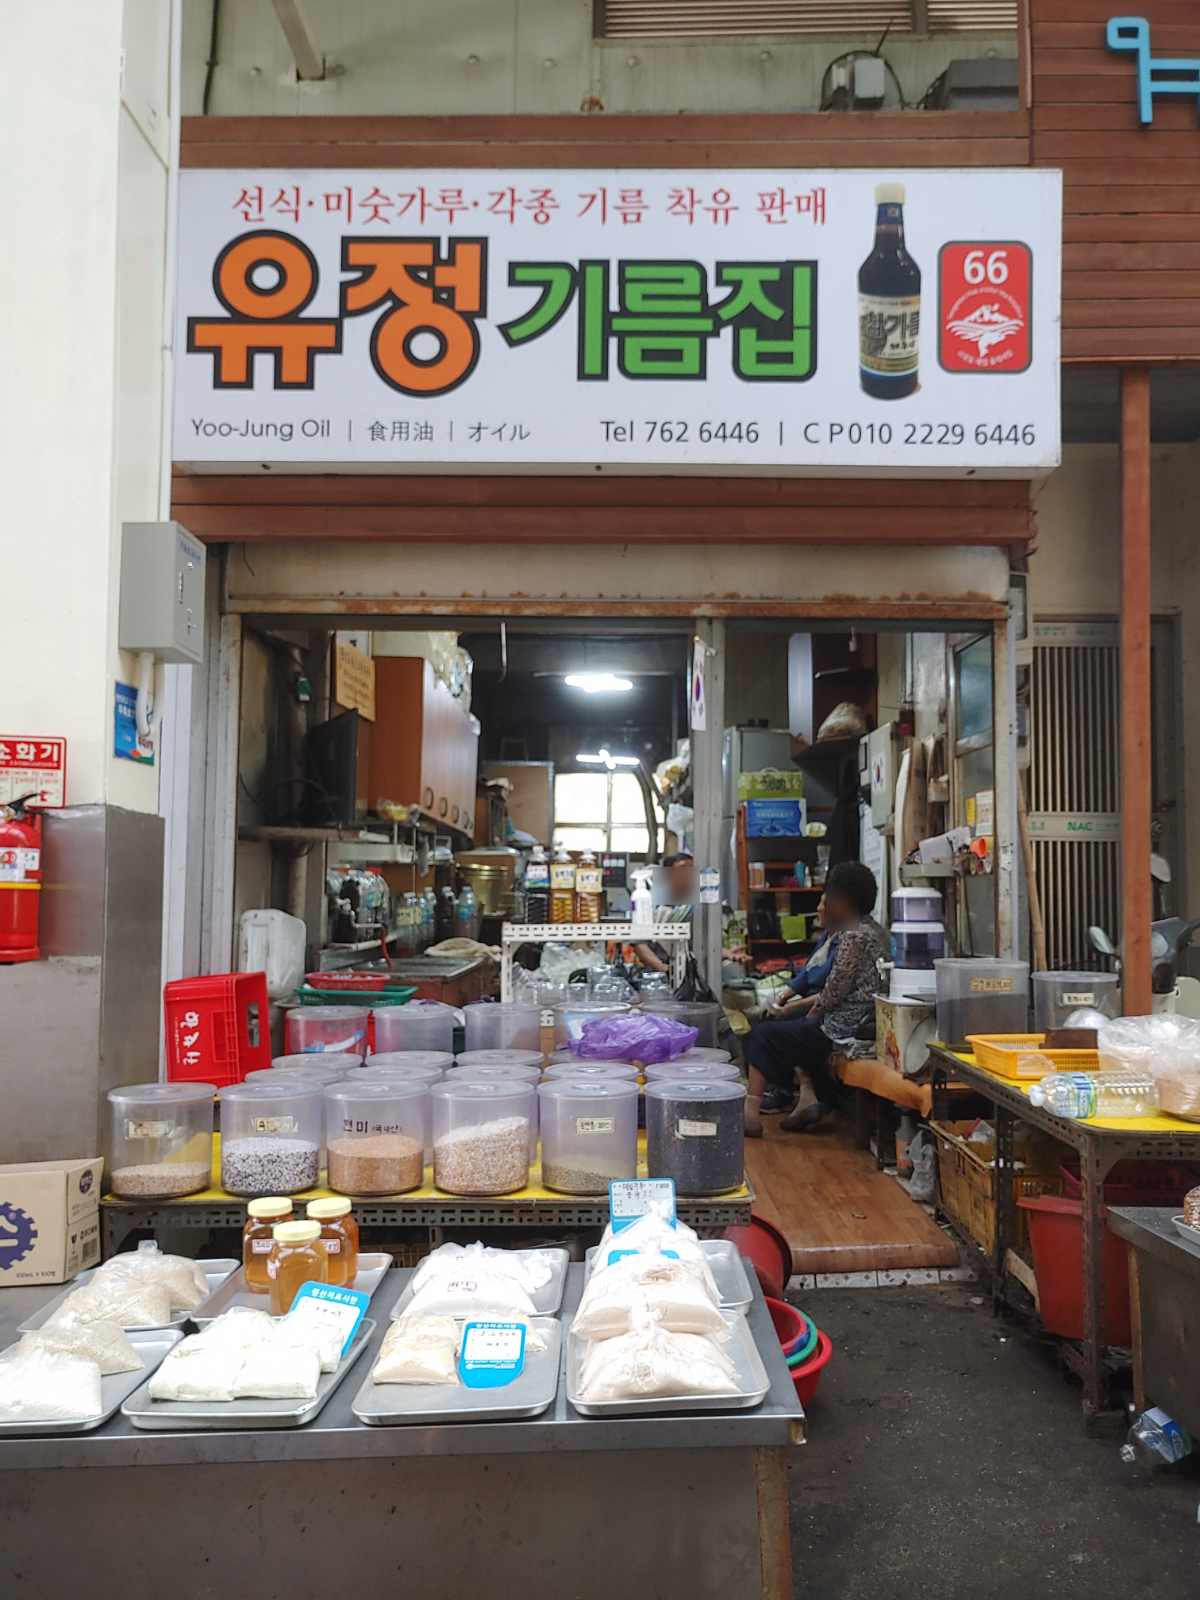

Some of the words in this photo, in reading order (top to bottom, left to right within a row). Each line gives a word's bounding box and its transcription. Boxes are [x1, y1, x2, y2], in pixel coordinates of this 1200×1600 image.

[578, 187, 650, 225] 기름
[665, 187, 740, 225] 착유
[755, 187, 827, 225] 판매
[963, 250, 1009, 285] 66
[187, 229, 489, 398] 유정
[495, 259, 818, 382] 기름집
[192, 418, 294, 442] Yoo-Jung
[301, 418, 331, 438] Oil
[368, 420, 434, 442] 食用油
[468, 422, 531, 443] オイル
[600, 420, 634, 443] Tel
[645, 420, 690, 443] 762
[699, 420, 760, 444] 6446
[903, 423, 965, 446] 2229
[974, 423, 1036, 446] 6446
[0, 742, 59, 763] 소화기
[343, 1119, 368, 1134] 현미
